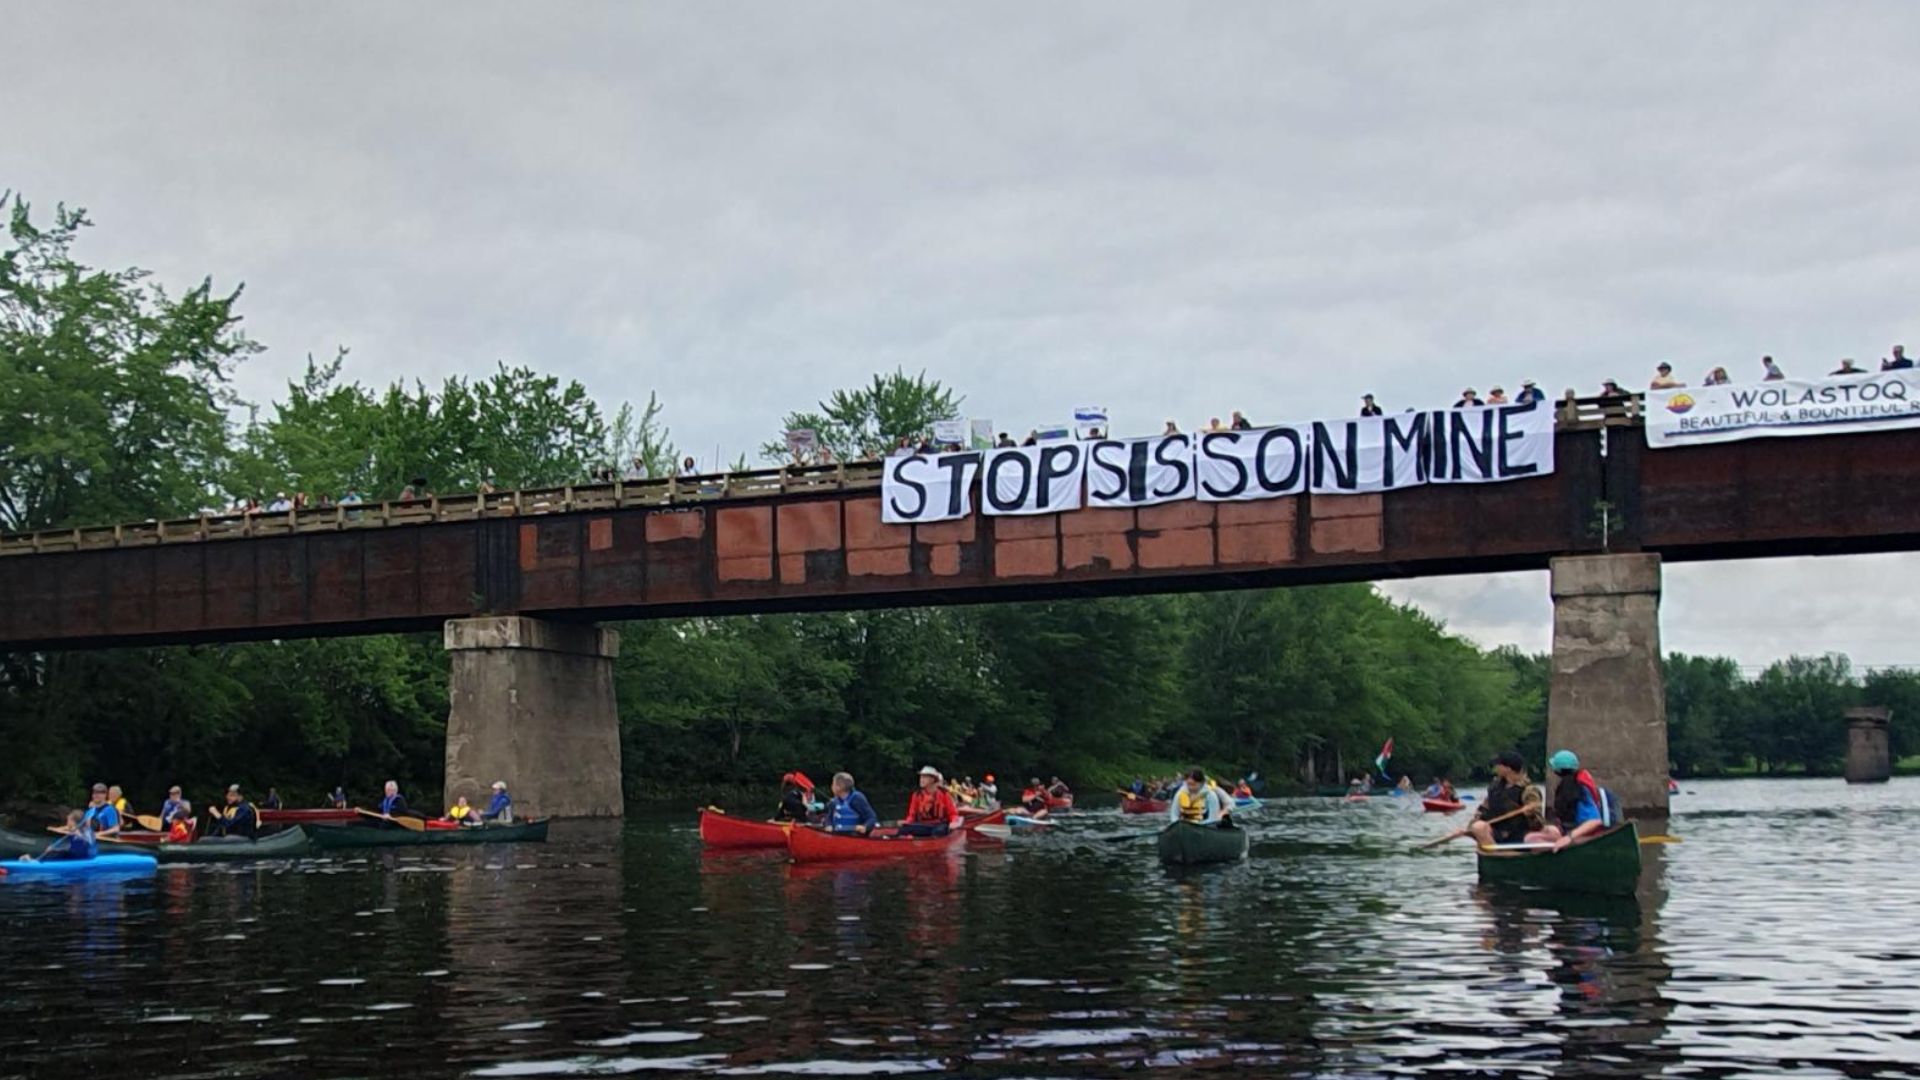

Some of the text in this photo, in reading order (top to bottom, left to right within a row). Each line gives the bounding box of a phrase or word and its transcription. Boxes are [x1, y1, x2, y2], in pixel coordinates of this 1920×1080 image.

[1731, 380, 1907, 408] WOLASTOQ
[1680, 410, 1775, 430] BEAUTIFUL
[1779, 410, 1791, 422] &
[1799, 404, 1903, 420] BOUNTIFUL
[890, 401, 1537, 519] STOP SISSON MINE
